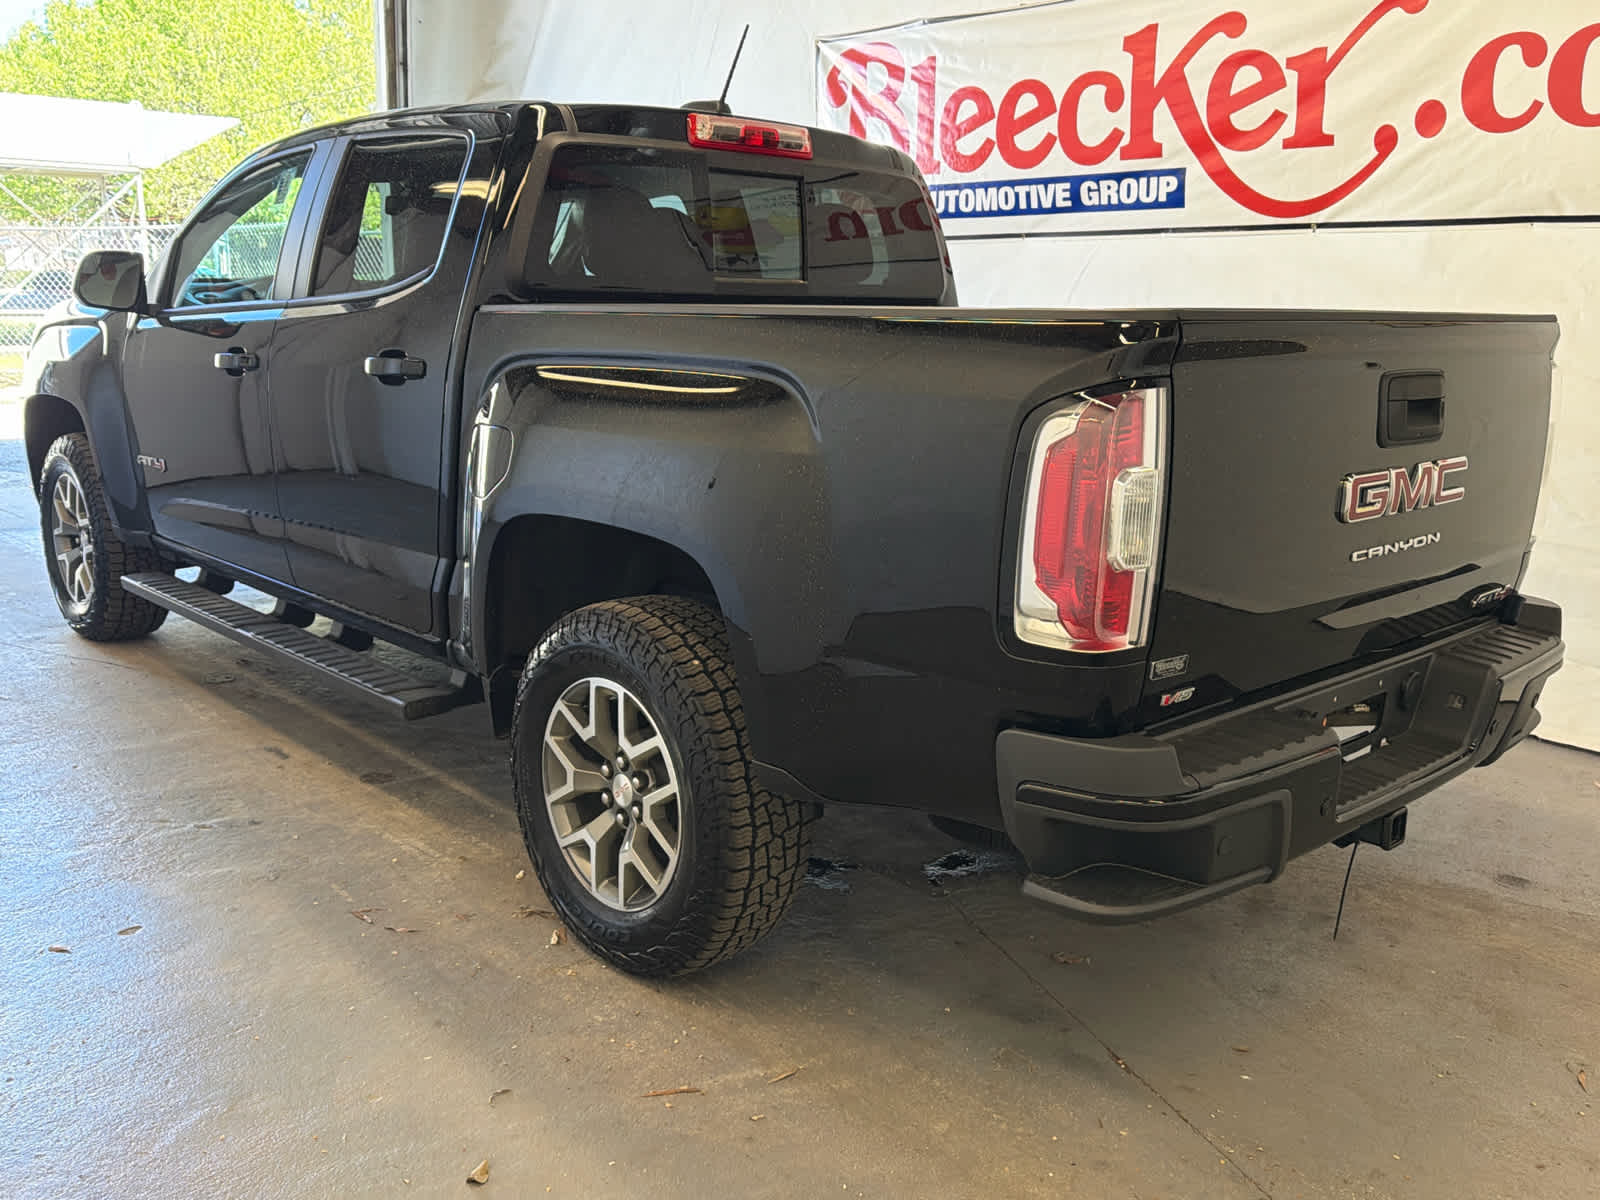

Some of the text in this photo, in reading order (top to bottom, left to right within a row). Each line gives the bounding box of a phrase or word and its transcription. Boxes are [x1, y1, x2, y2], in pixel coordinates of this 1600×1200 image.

[930, 175, 1178, 214] UTOMOTIVE GROUP
[1341, 455, 1469, 524] GMC
[1351, 532, 1441, 562] CANYON
